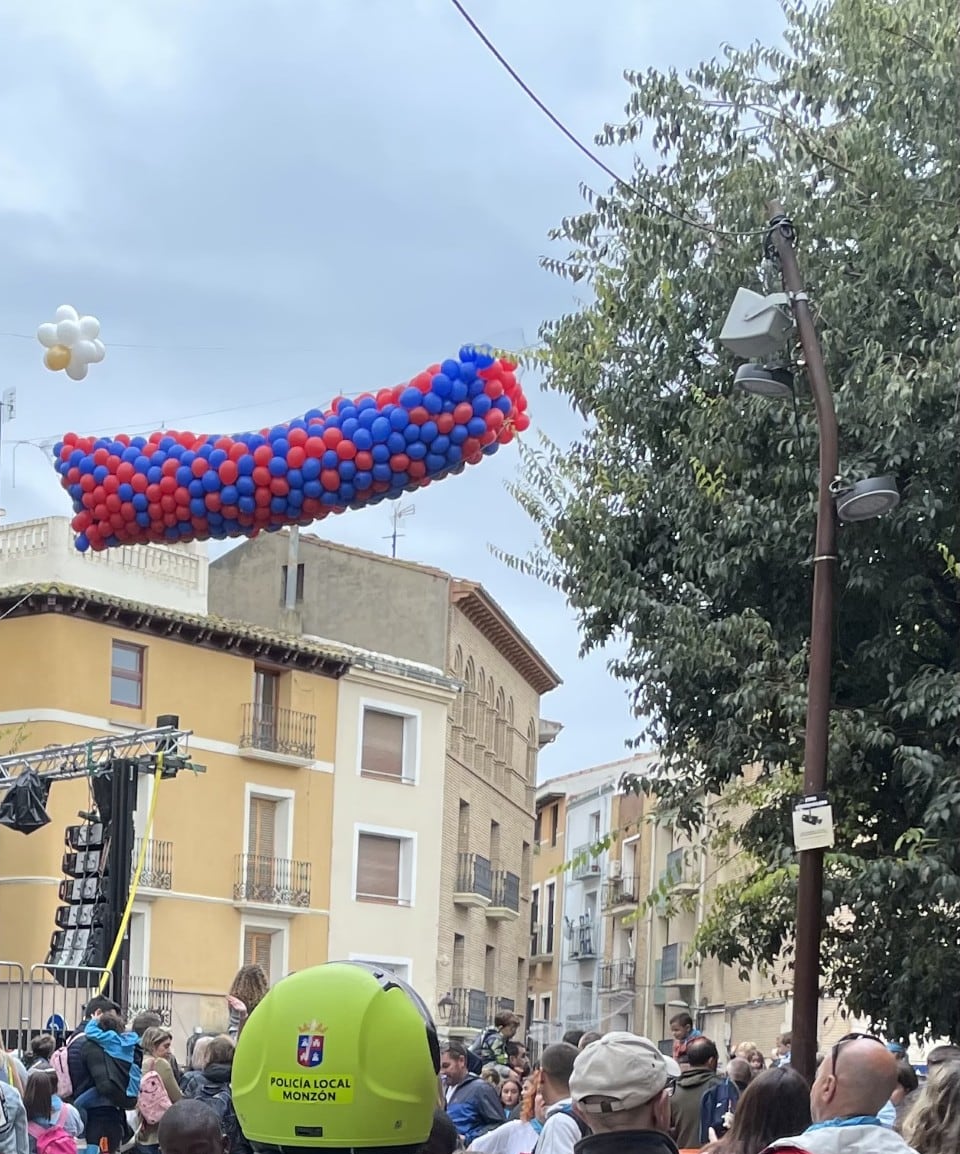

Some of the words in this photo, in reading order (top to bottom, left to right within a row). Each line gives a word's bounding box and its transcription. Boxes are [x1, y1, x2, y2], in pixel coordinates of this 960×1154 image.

[270, 1077, 311, 1089] POLICÍA
[313, 1079, 351, 1089] LOCAL
[282, 1090, 336, 1102] MONZÓN
